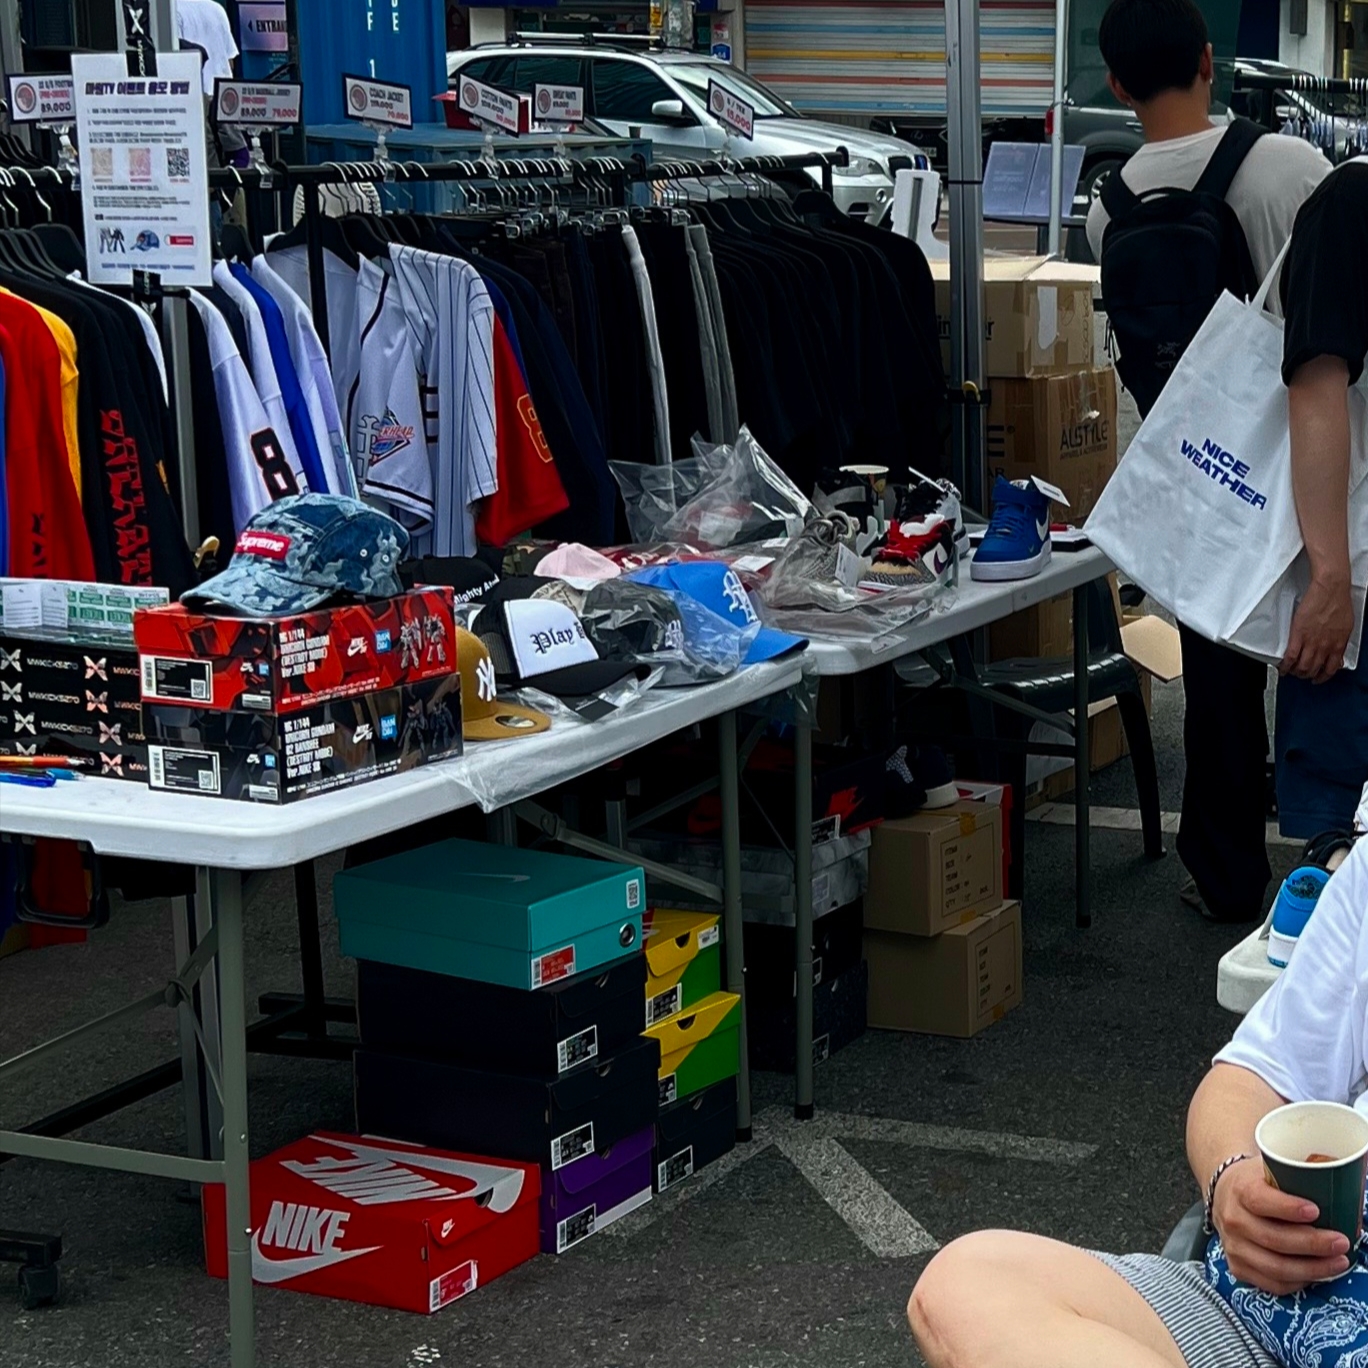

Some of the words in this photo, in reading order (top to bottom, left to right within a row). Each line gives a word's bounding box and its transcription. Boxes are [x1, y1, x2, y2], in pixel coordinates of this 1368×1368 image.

[251, 426, 300, 501] 8
[1180, 439, 1267, 510] WEATHER
[1202, 438, 1250, 479] NICE
[237, 532, 285, 552] Supreme
[529, 627, 575, 655] Play
[262, 1201, 351, 1254] NIKE
